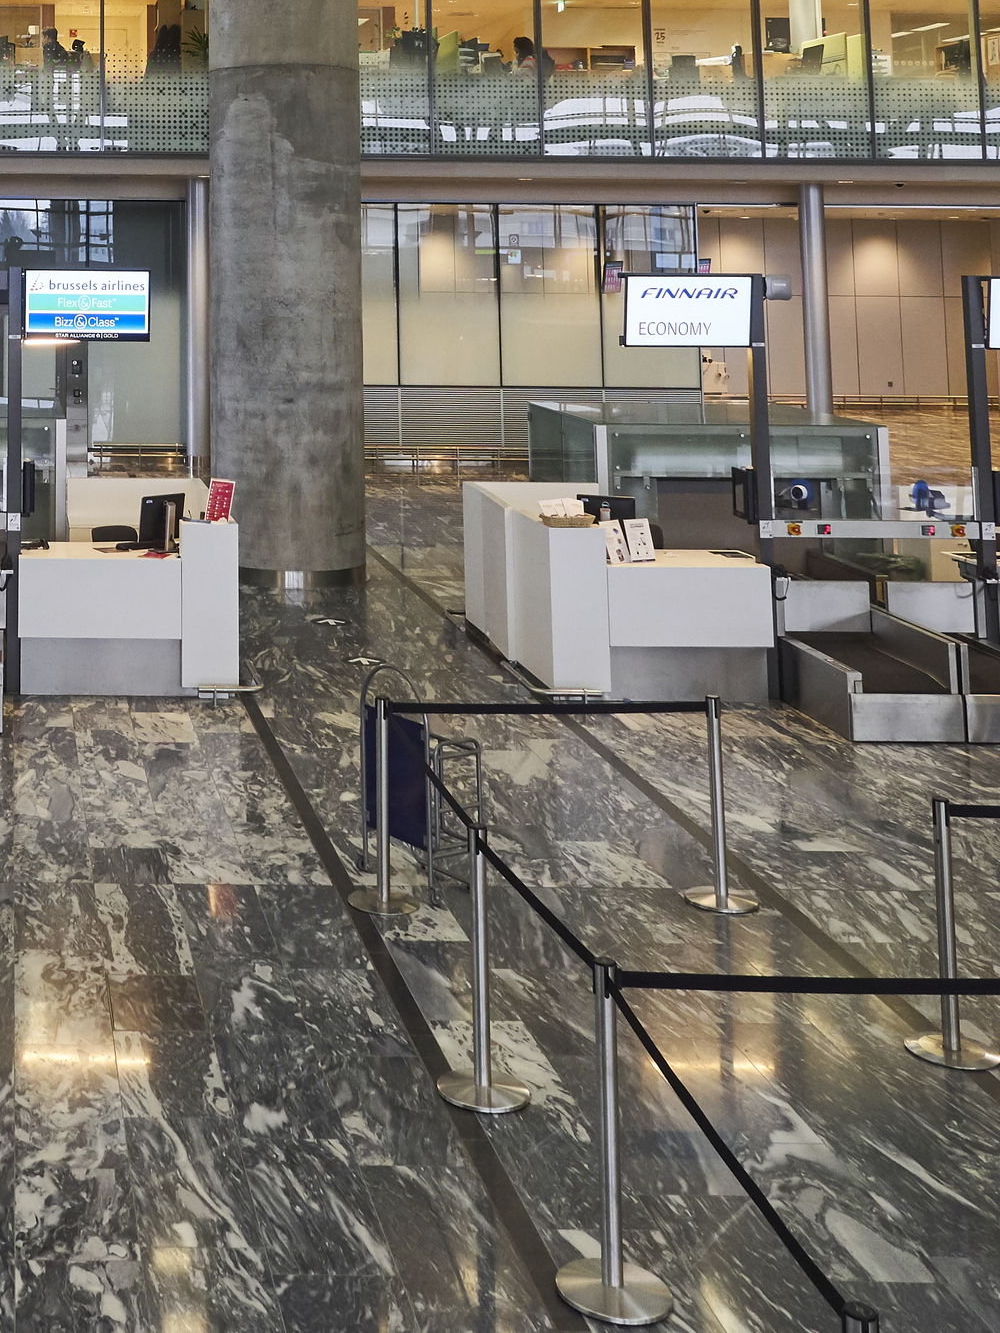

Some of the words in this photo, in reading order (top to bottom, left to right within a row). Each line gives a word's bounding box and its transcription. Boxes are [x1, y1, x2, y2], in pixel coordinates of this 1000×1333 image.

[49, 279, 98, 291] brussels
[101, 280, 145, 291] airlines
[640, 287, 739, 299] FINNAIR
[638, 321, 712, 336] ECONOMY
